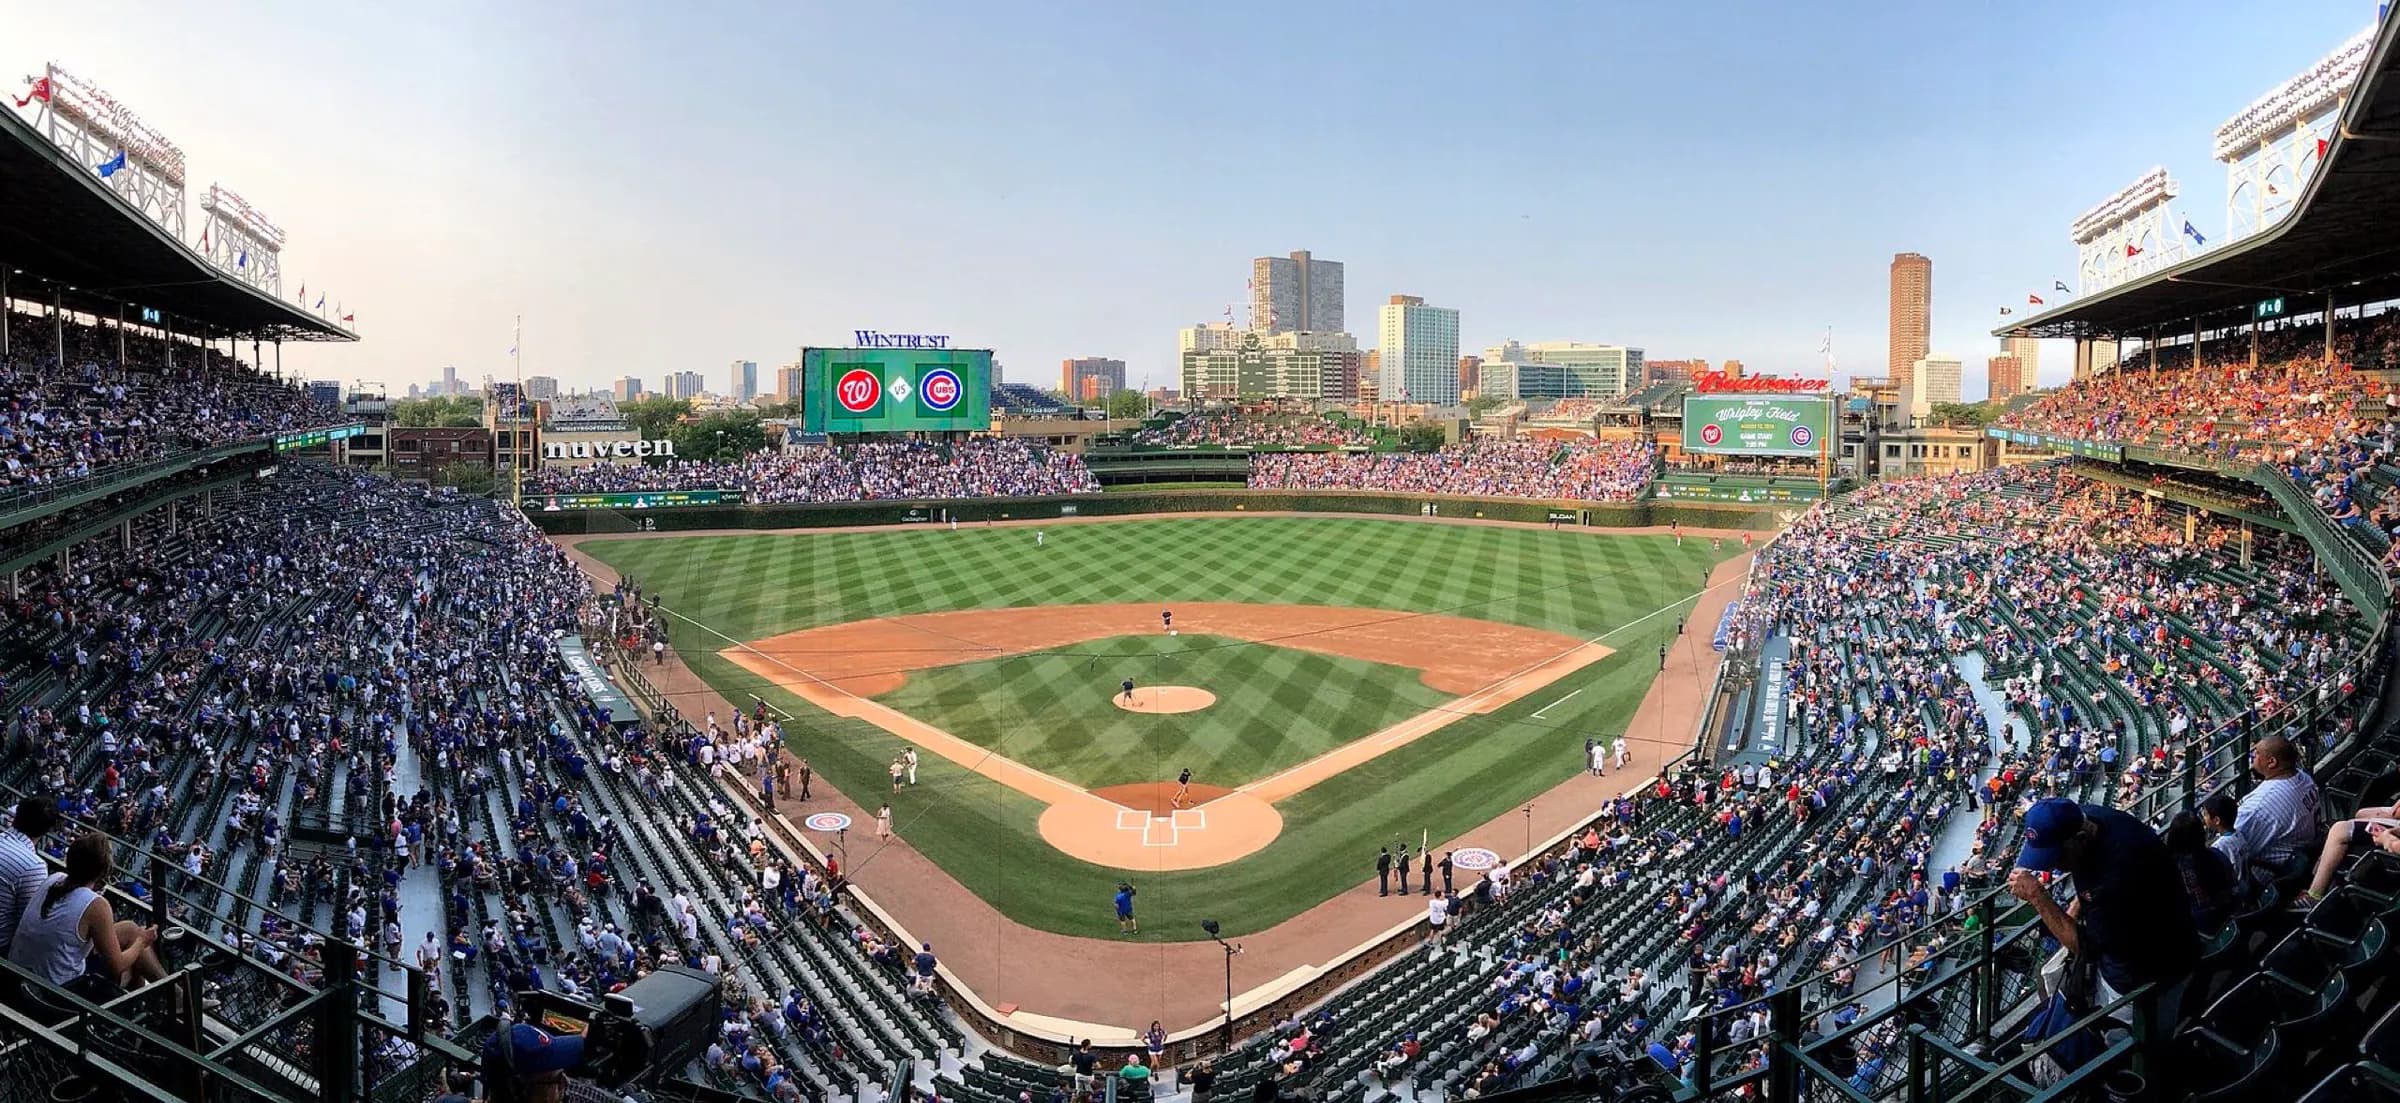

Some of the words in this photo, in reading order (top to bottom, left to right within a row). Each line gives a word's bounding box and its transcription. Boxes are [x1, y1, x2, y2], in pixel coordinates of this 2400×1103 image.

[1692, 371, 1829, 393] Budweiser
[1715, 405, 1763, 421] Wrigley
[1766, 406, 1801, 421] Field
[544, 439, 675, 458] nuveen
